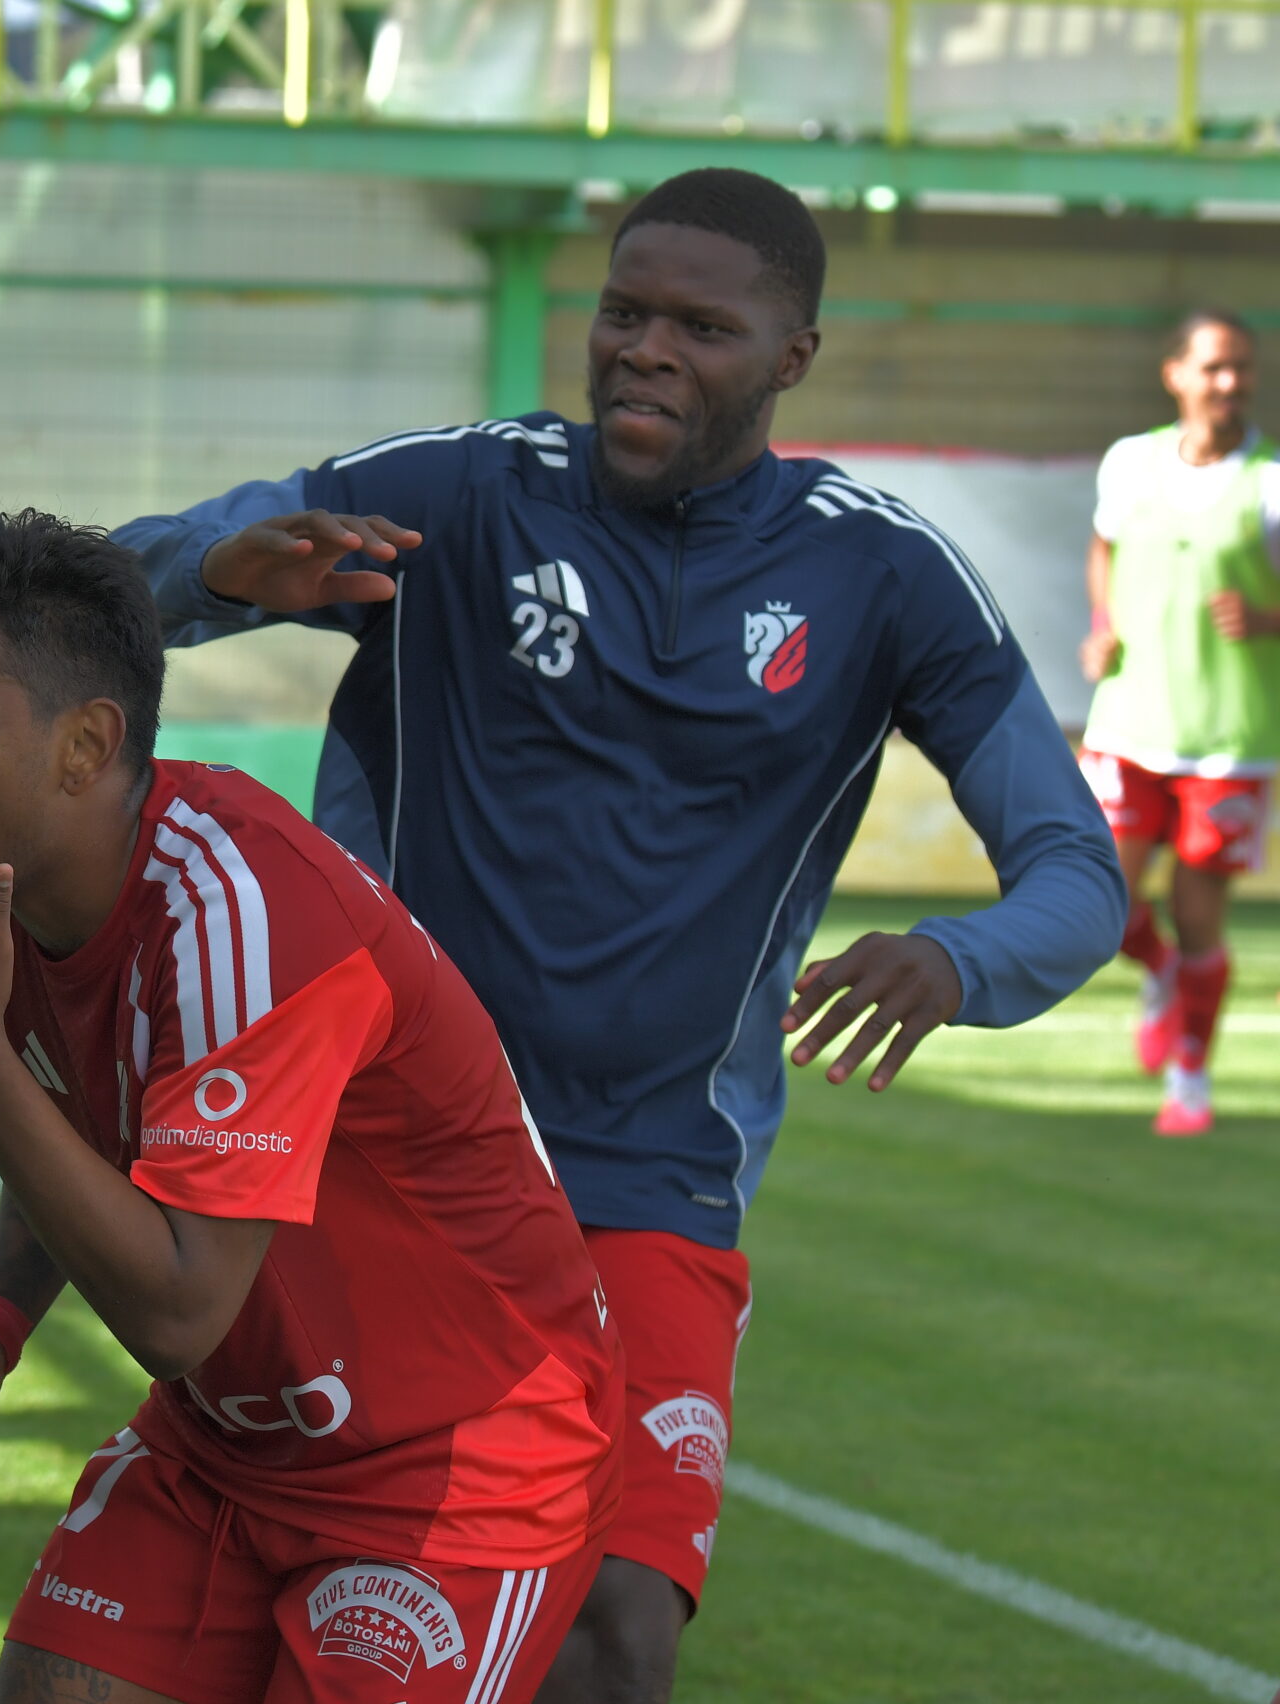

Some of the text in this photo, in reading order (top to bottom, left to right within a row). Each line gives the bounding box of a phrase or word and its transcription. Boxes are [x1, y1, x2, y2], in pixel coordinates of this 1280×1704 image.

[510, 602, 581, 678] 23
[141, 1122, 292, 1155] optimdiagnostic
[654, 1408, 688, 1436] FIVE
[40, 1573, 125, 1622] Vestra
[315, 1575, 453, 1653] FIVE CONTINENTS
[347, 1643, 383, 1661] GROUP
